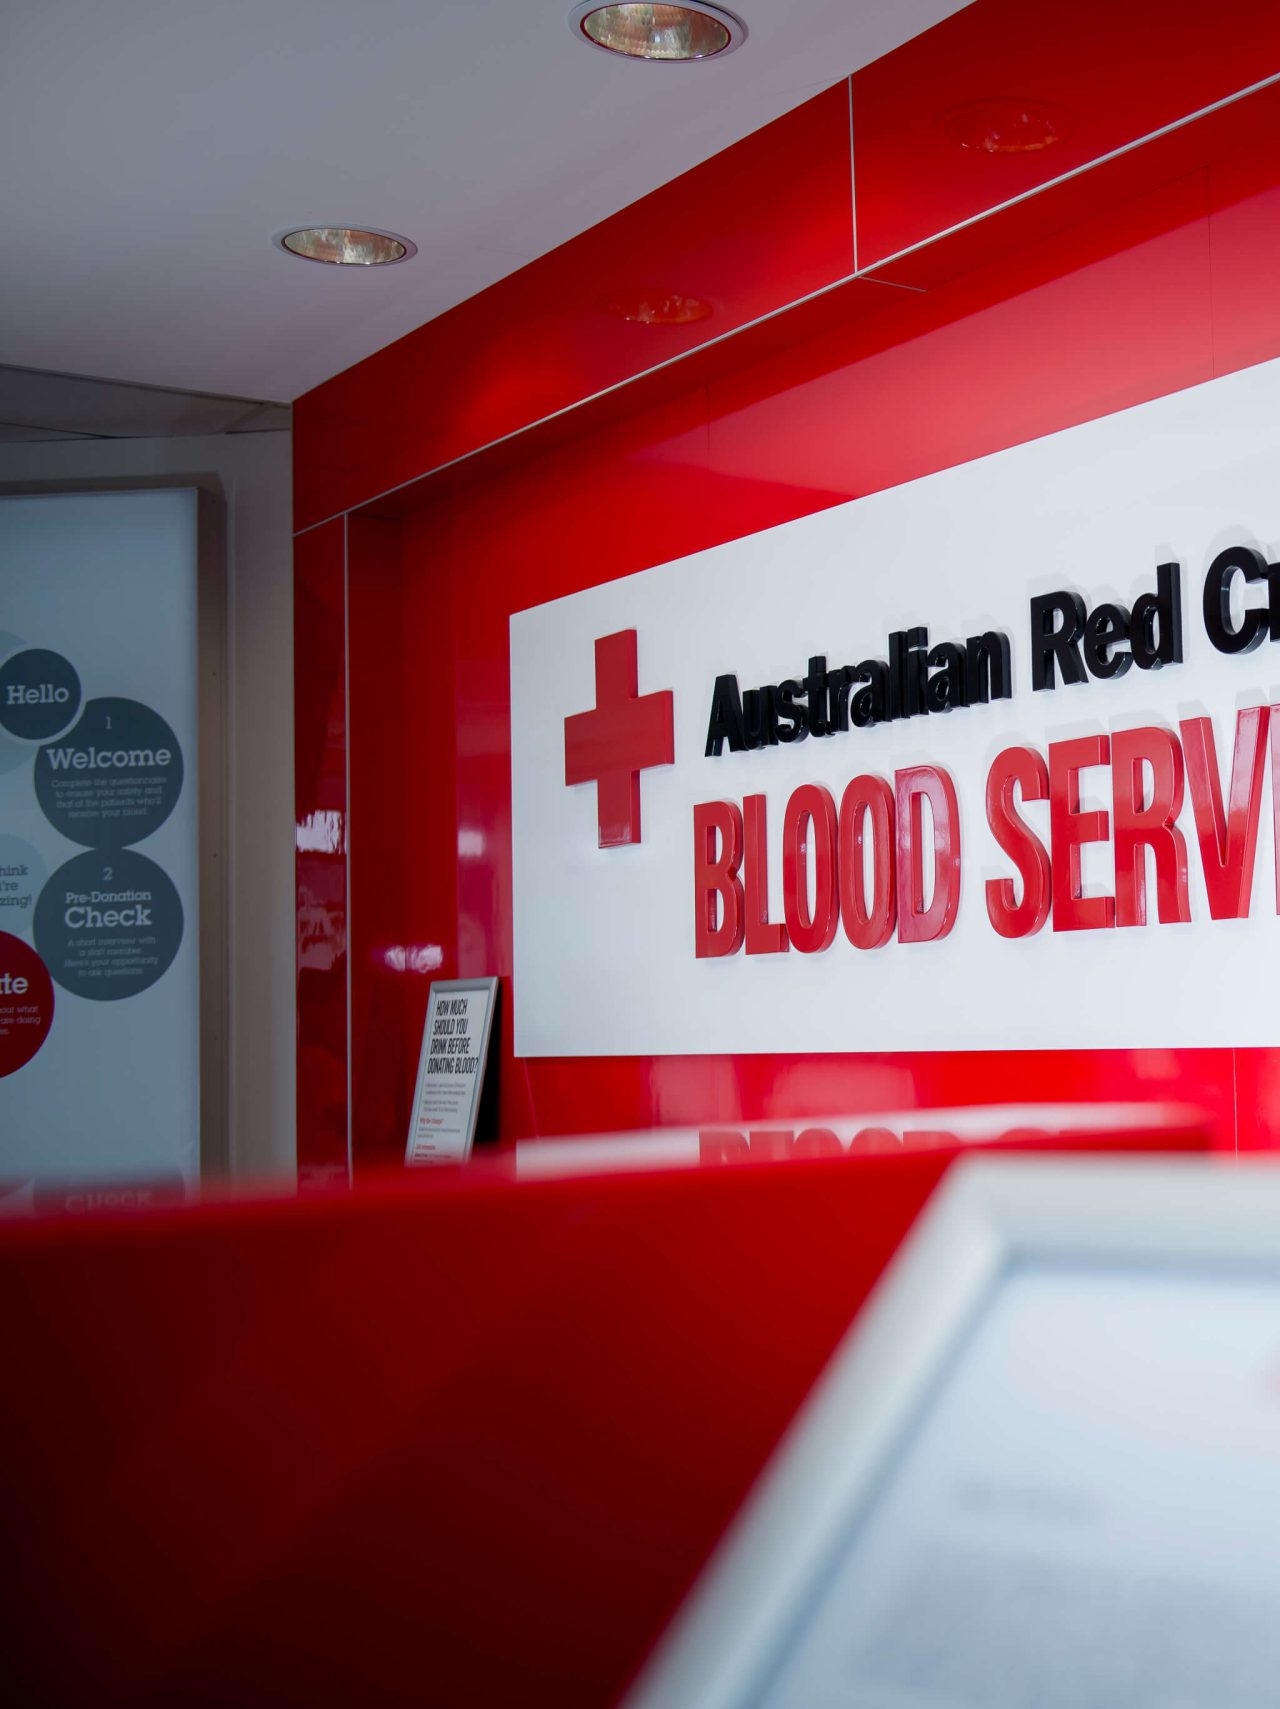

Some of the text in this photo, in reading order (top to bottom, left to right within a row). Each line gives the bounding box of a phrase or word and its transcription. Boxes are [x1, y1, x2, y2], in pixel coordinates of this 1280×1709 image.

[704, 626, 1012, 757] Australian
[1030, 562, 1184, 692] Red
[6, 683, 70, 705] Hello
[105, 716, 113, 729] 1
[46, 747, 171, 770] Welcome
[96, 789, 115, 799] your
[144, 786, 162, 795] and
[101, 809, 121, 819] your
[693, 765, 961, 960] BLOOD
[103, 867, 113, 881] 2
[65, 889, 152, 904] Pre-Donation
[64, 904, 153, 929] Check
[91, 959, 109, 968] your
[435, 998, 468, 1016] HOW MUCH
[433, 1018, 469, 1035] SHOULD YOU
[430, 1037, 471, 1055] DRINK BEFORE
[427, 1056, 479, 1075] DONATING BLOOD?
